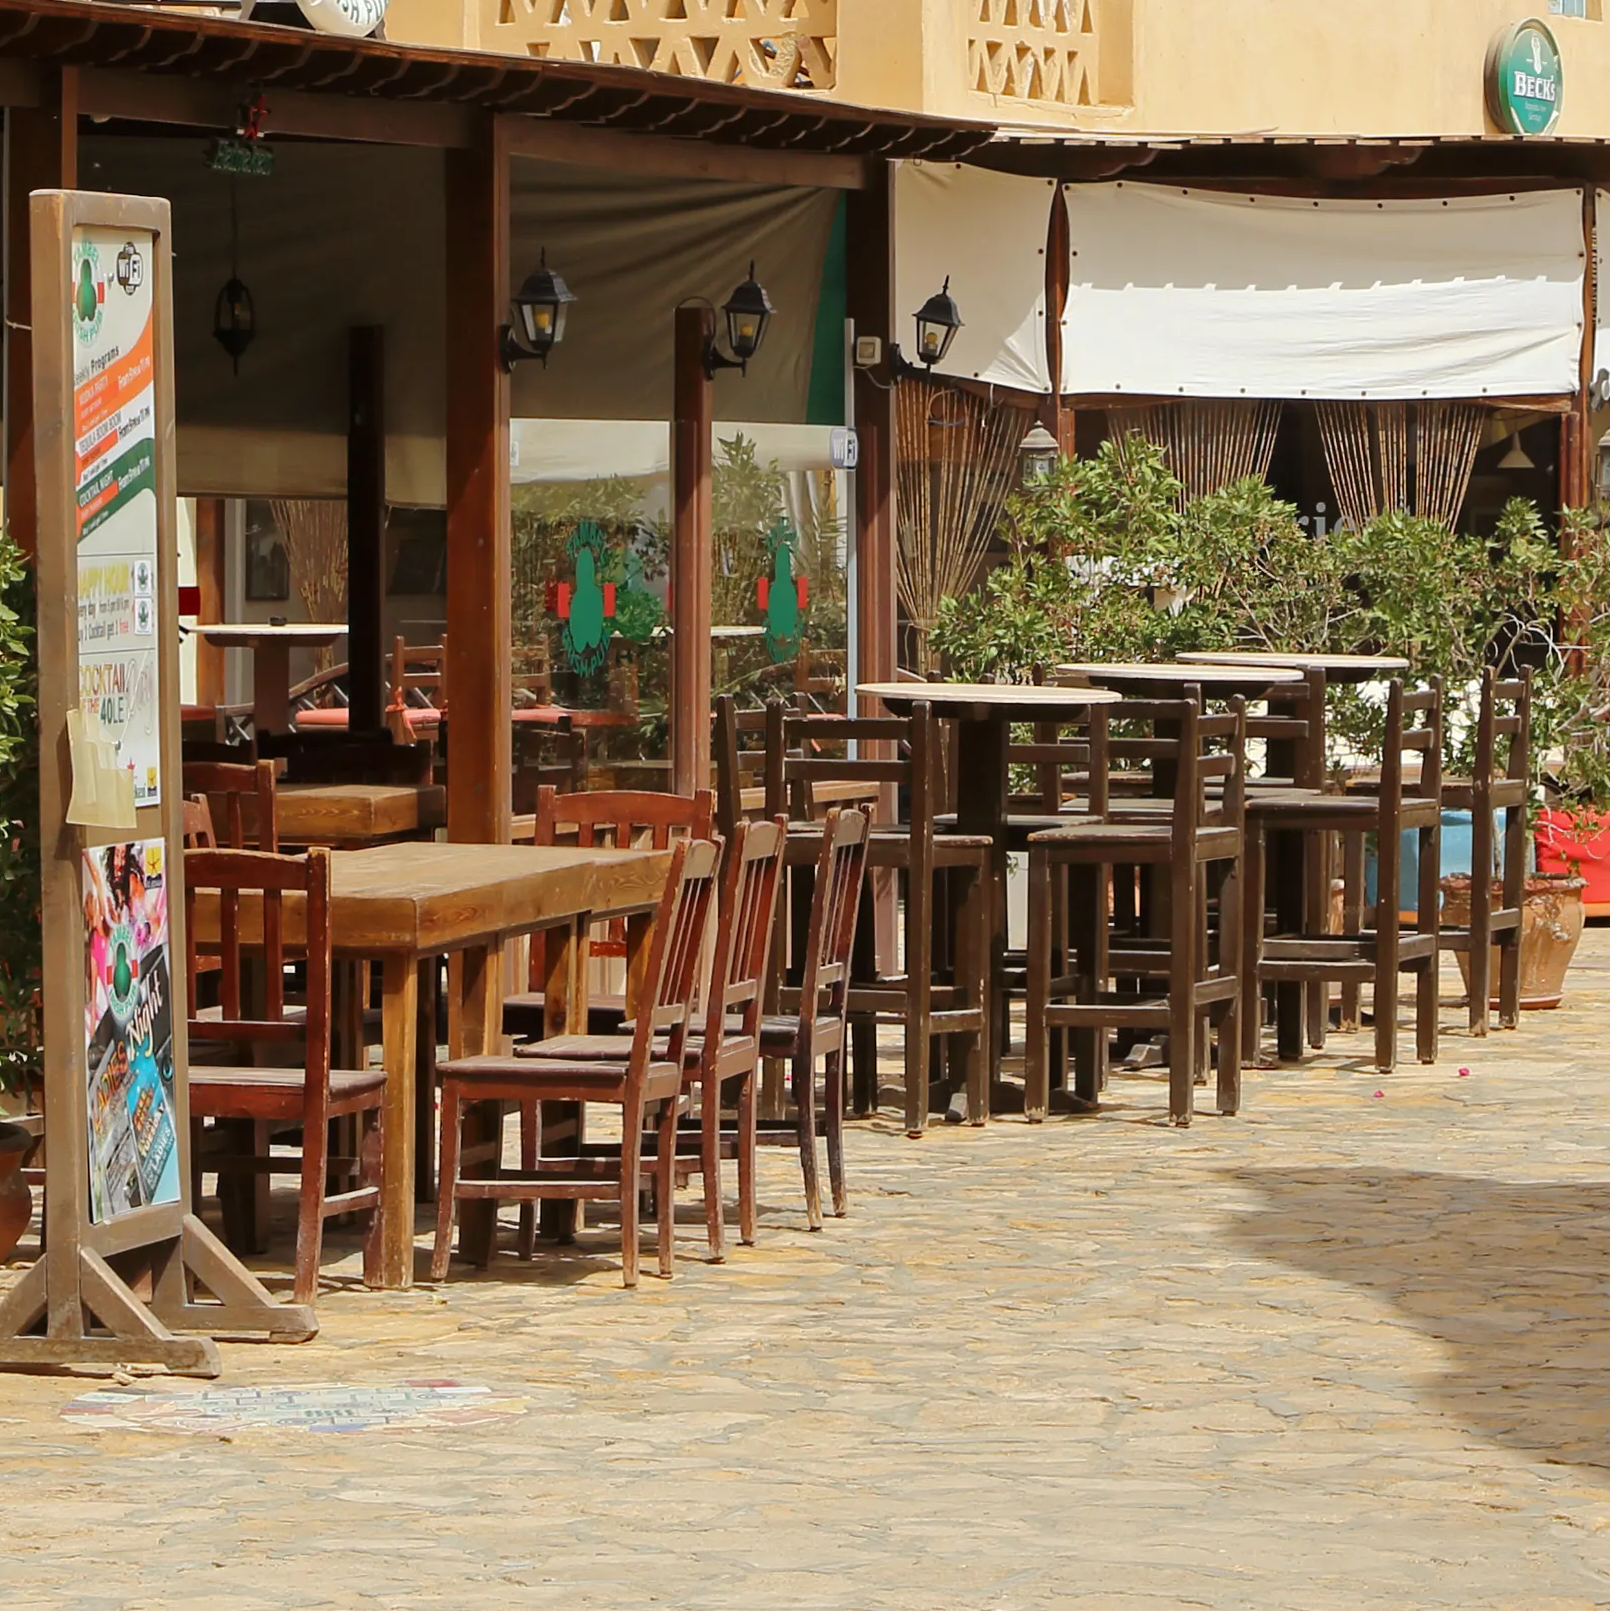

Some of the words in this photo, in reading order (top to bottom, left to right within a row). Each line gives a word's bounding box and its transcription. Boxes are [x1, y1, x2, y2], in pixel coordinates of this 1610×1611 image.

[91, 345, 119, 374] Programs
[833, 438, 856, 461] WiFi
[100, 695, 126, 726] 40LE
[125, 969, 163, 1062] Night
[93, 1040, 129, 1133] LADIES
